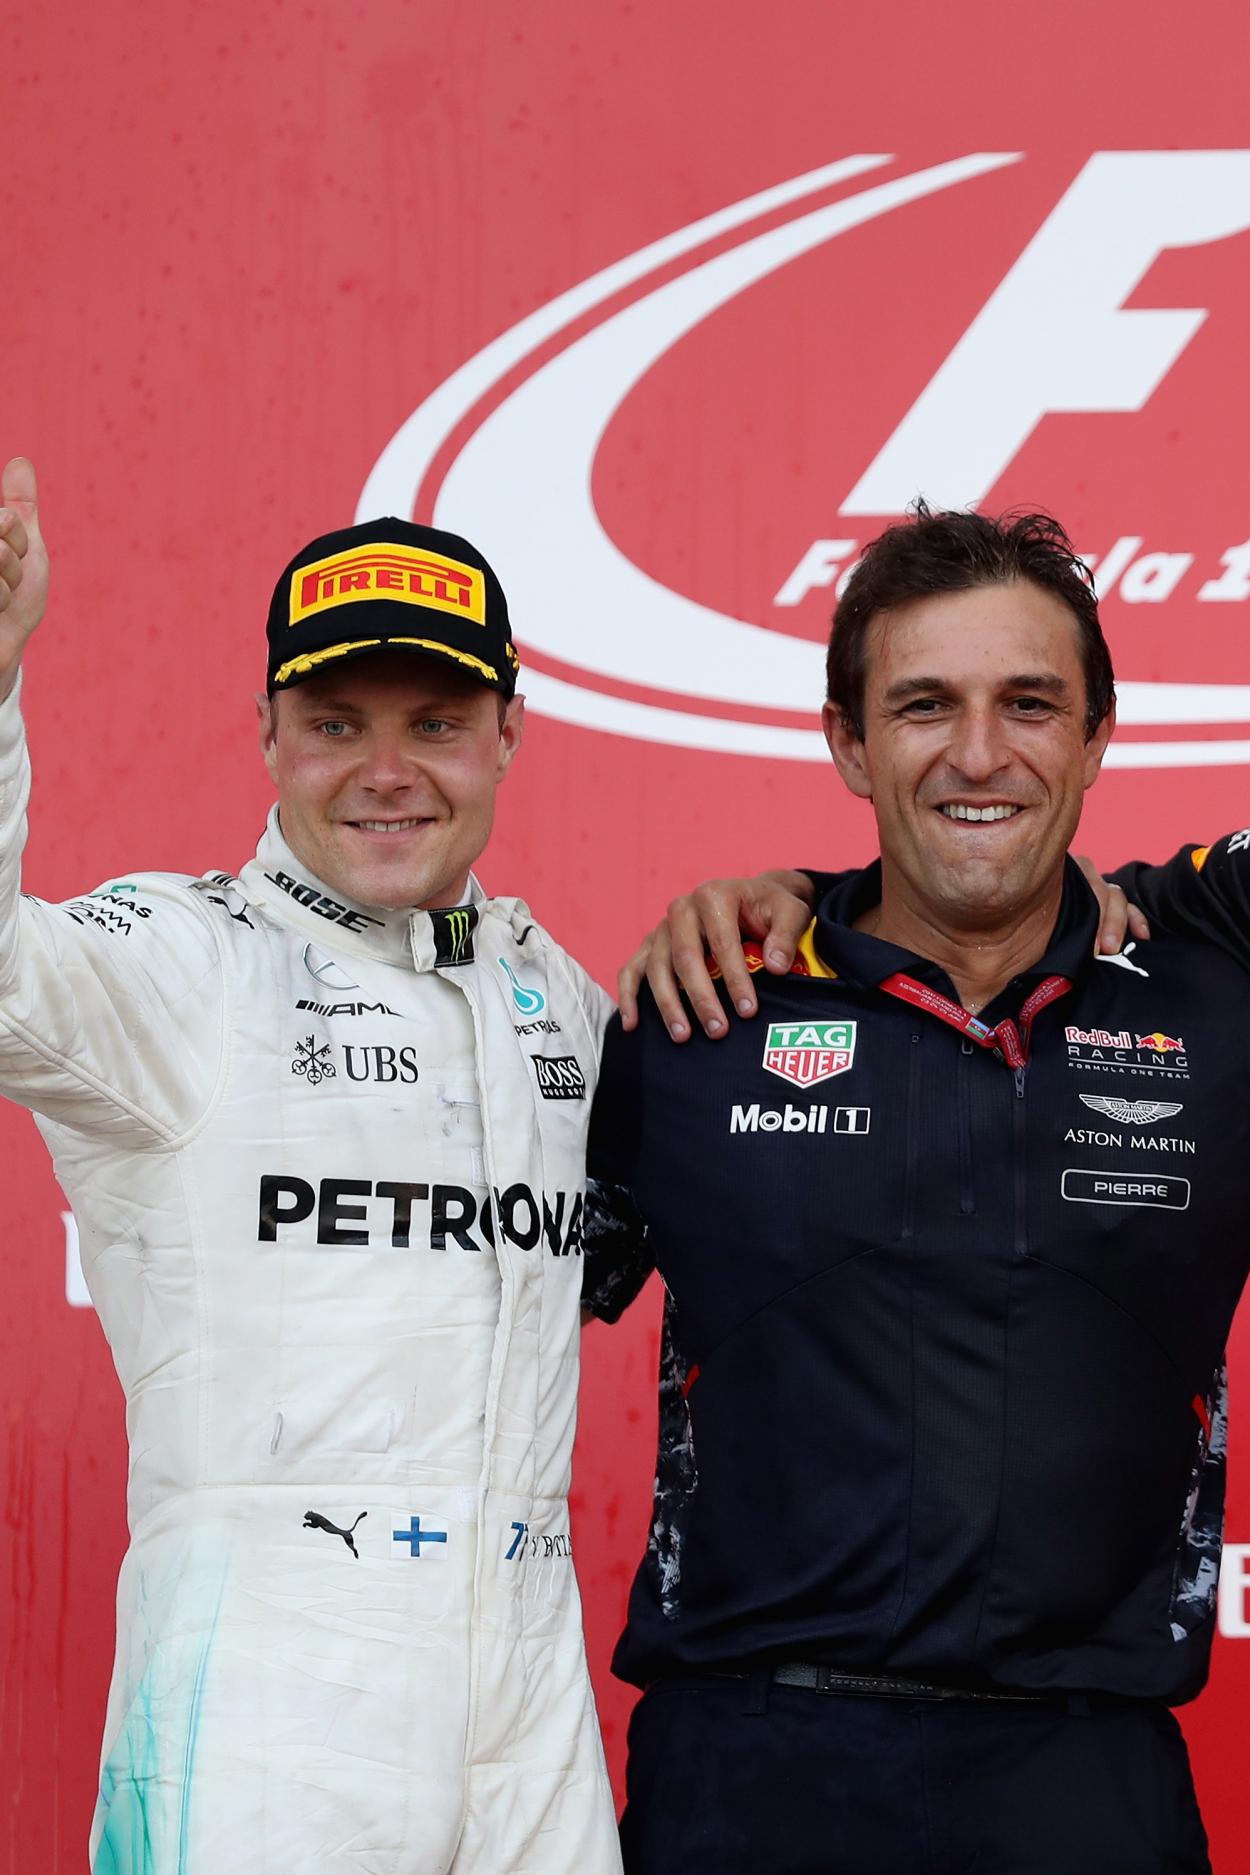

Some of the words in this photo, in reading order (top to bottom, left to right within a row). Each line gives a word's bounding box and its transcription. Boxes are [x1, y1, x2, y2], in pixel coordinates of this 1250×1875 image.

[300, 554, 473, 609] PIRELLI
[264, 871, 386, 934] BOSE
[775, 1027, 847, 1047] TAG
[1065, 1026, 1100, 1046] Red
[1099, 1030, 1132, 1049] Bull
[341, 1045, 419, 1084] UBS
[768, 1051, 848, 1082] HEUER
[1068, 1045, 1188, 1067] RACING
[536, 1058, 584, 1087] BOSS
[1068, 1062, 1125, 1073] FORMULA
[1130, 1068, 1154, 1077] ONE
[1159, 1071, 1191, 1080] TEAM
[730, 1104, 828, 1133] Mobil
[1064, 1128, 1122, 1147] ASTON
[1130, 1136, 1196, 1154] MARTIN
[1094, 1181, 1168, 1197] PIERRE
[257, 1174, 584, 1257] PETRONA
